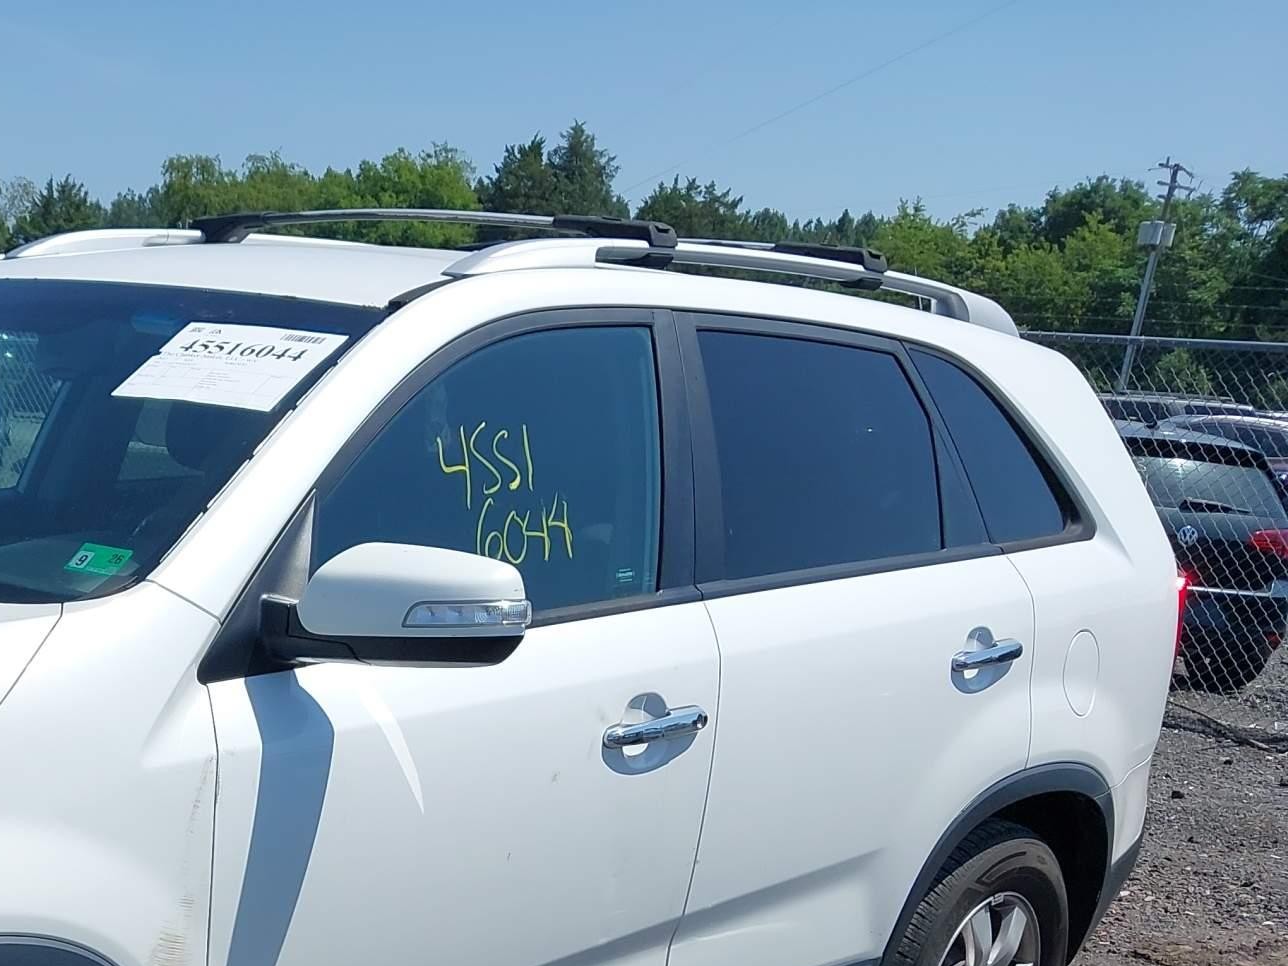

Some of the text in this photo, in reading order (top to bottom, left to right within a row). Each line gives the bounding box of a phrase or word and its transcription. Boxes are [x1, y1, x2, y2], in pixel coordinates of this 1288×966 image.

[179, 338, 309, 363] 45516044
[436, 421, 533, 510] 4551
[476, 493, 573, 564] 6044
[75, 554, 89, 567] 9
